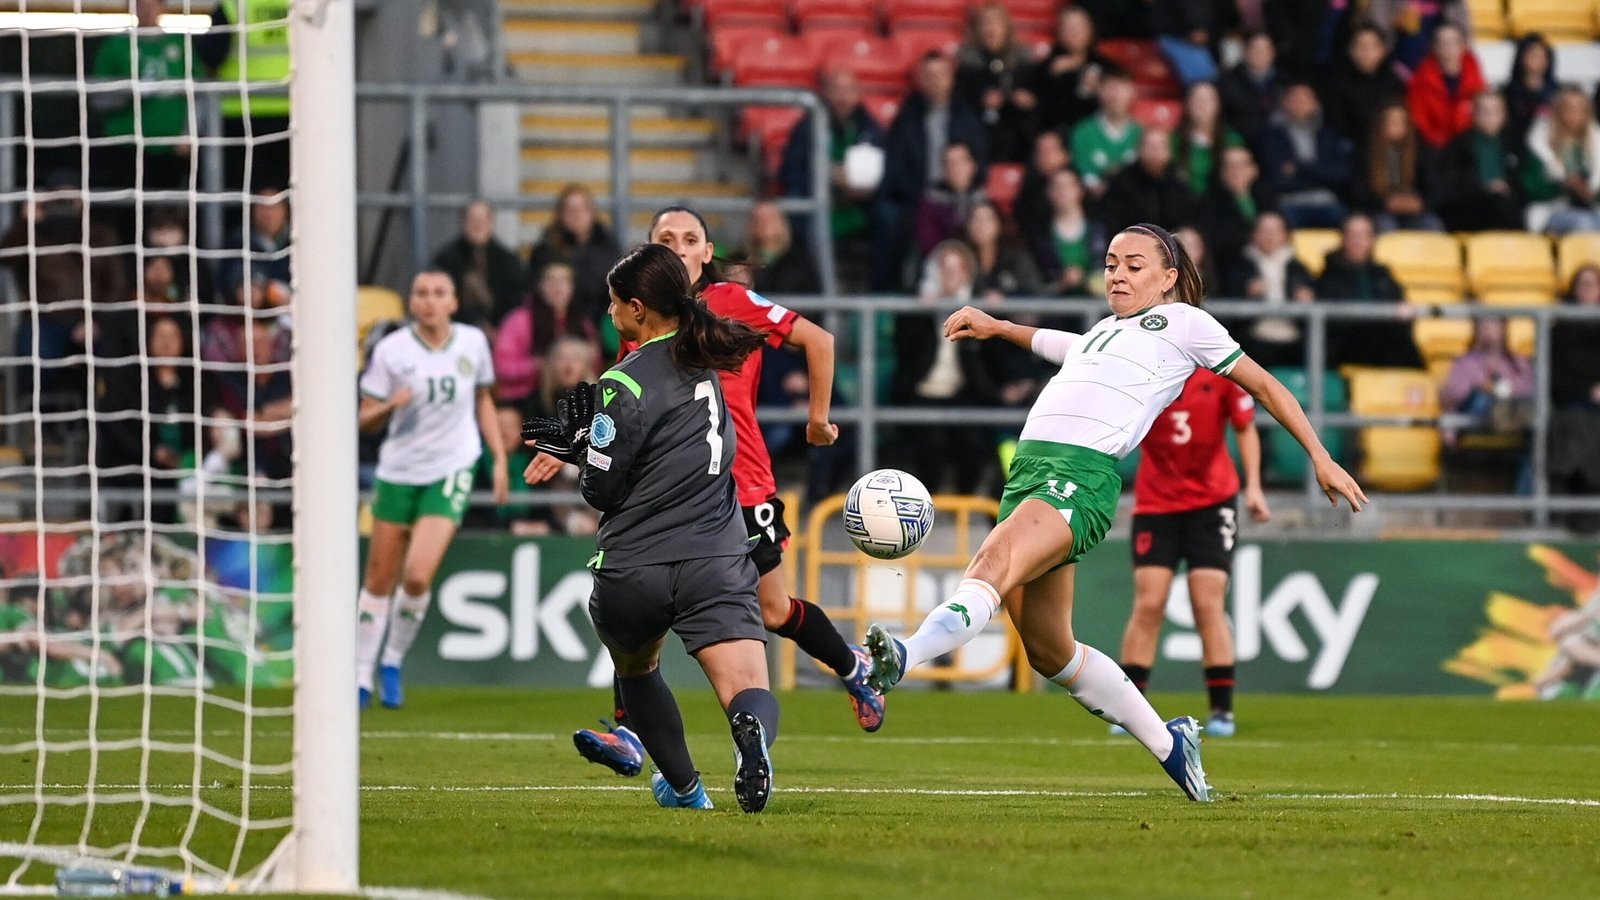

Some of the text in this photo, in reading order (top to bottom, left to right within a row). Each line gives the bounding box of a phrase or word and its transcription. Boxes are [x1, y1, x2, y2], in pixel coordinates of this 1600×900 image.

[1082, 328, 1123, 353] 11
[427, 376, 456, 402] 19
[694, 381, 723, 475] 1
[1170, 411, 1192, 444] 3
